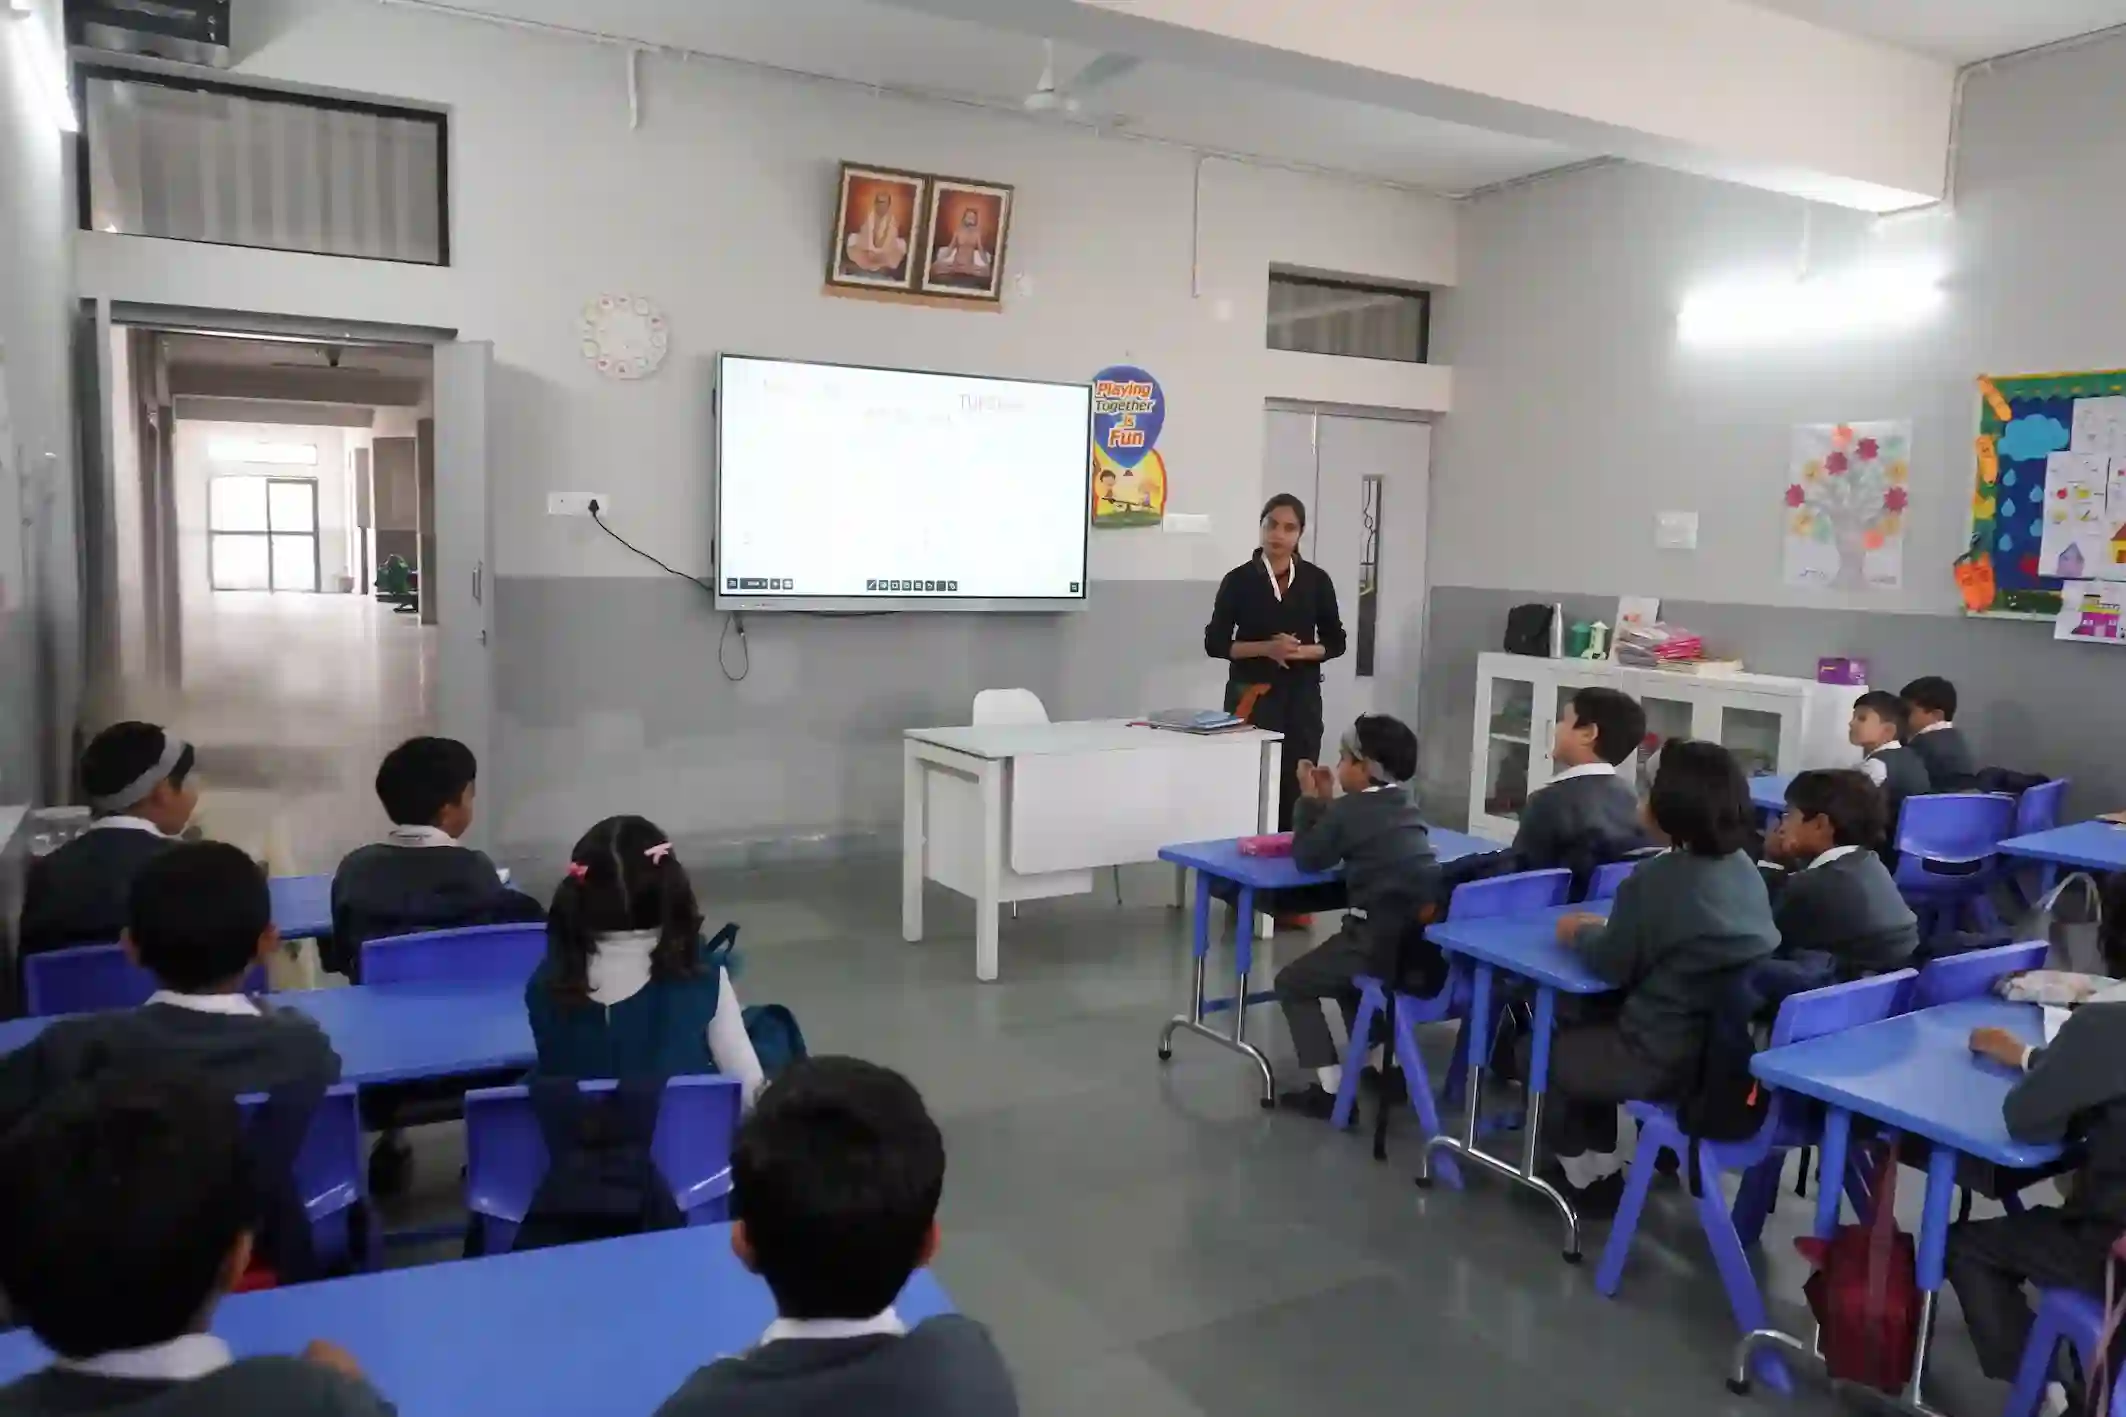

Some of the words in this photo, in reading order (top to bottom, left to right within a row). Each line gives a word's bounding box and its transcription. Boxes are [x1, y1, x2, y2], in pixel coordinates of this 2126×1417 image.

[1096, 382, 1151, 398] Playing
[1096, 400, 1153, 414] Together
[1109, 430, 1144, 446] Fun
